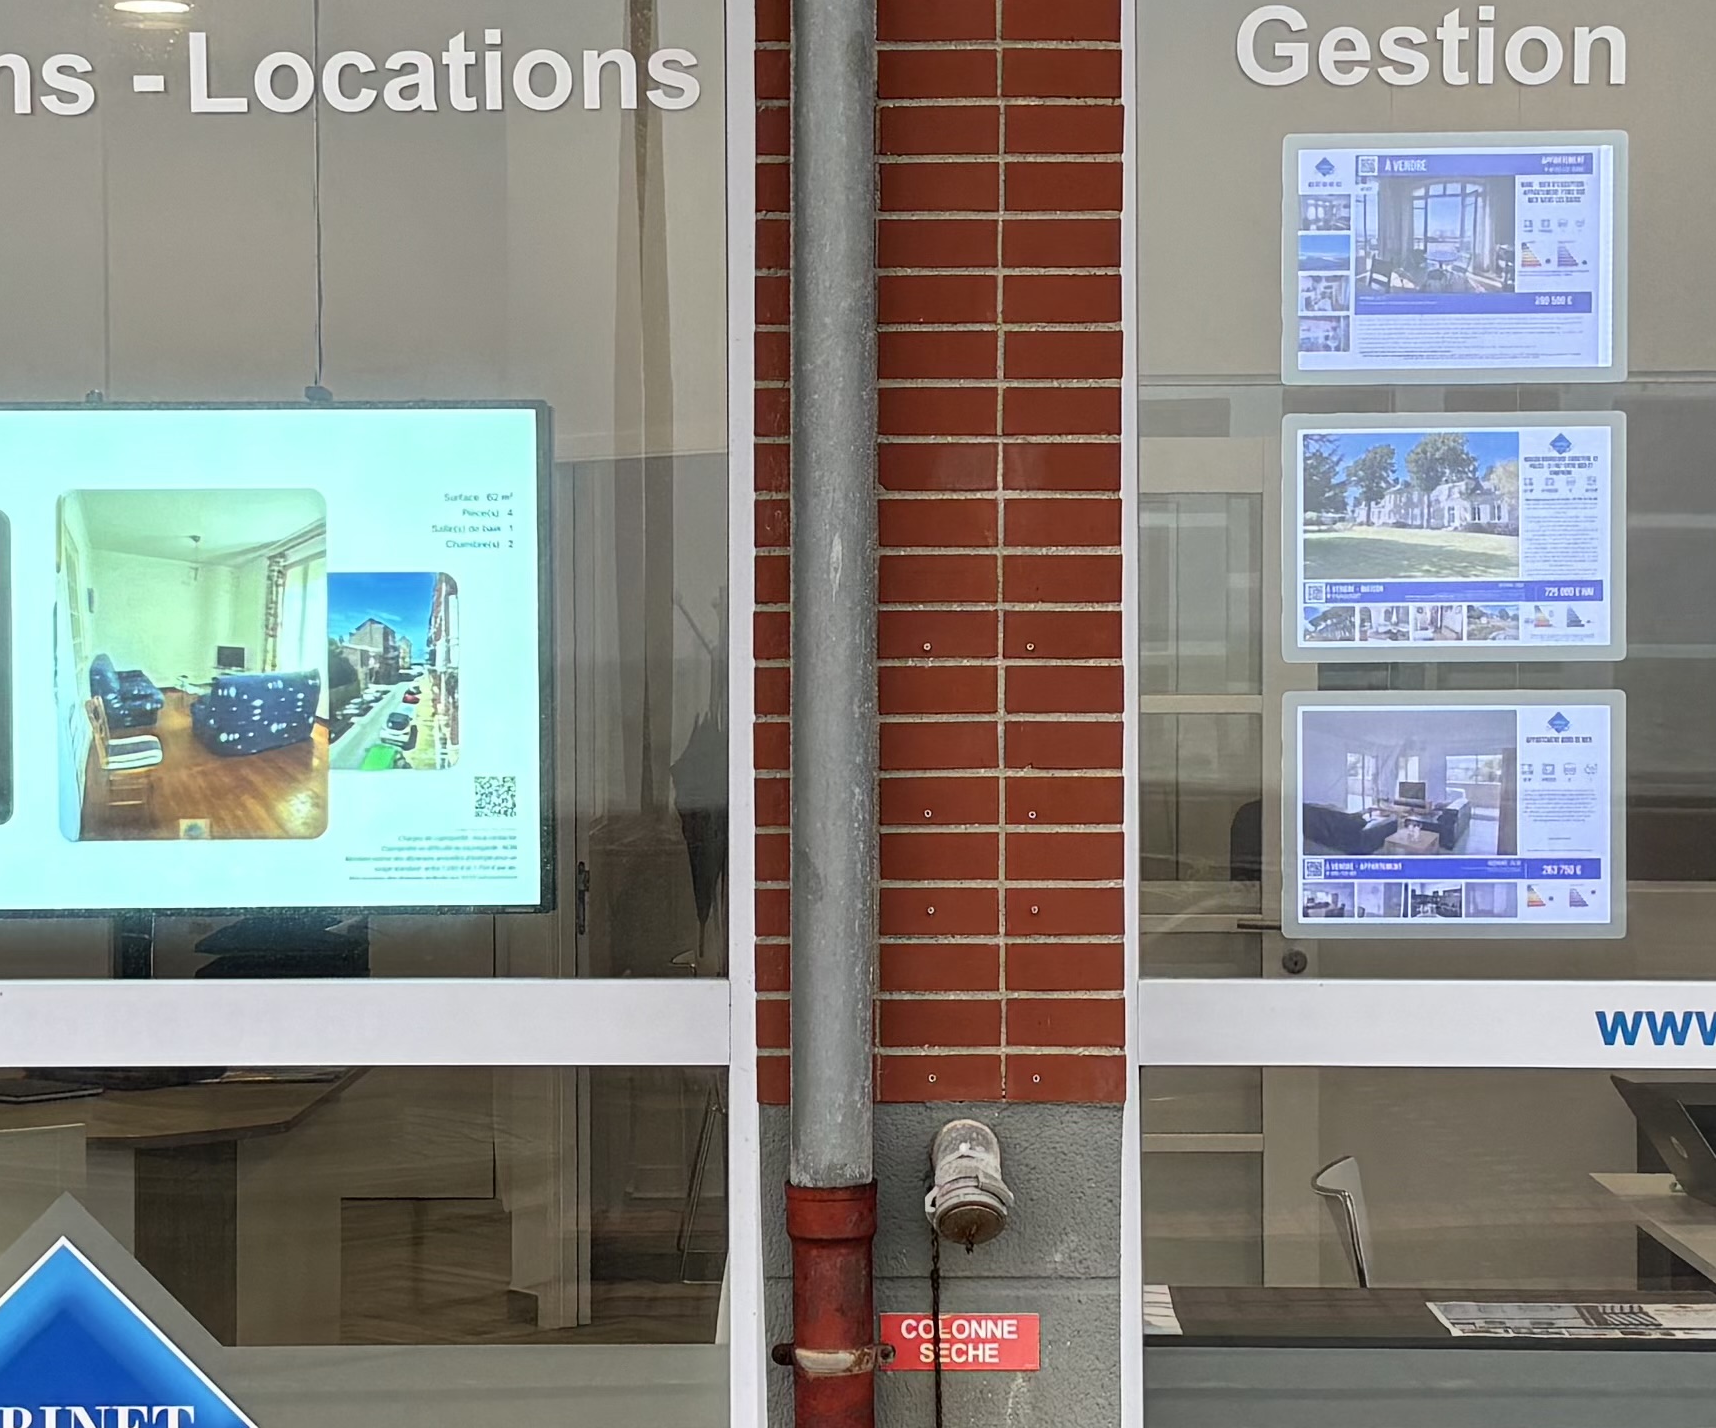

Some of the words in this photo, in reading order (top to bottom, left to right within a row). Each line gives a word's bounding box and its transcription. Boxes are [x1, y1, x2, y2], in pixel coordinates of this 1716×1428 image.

[1235, 2, 1628, 87] Gestion
[900, 1318, 1018, 1340] COLONNE
[919, 1342, 1000, 1363] SECHE
